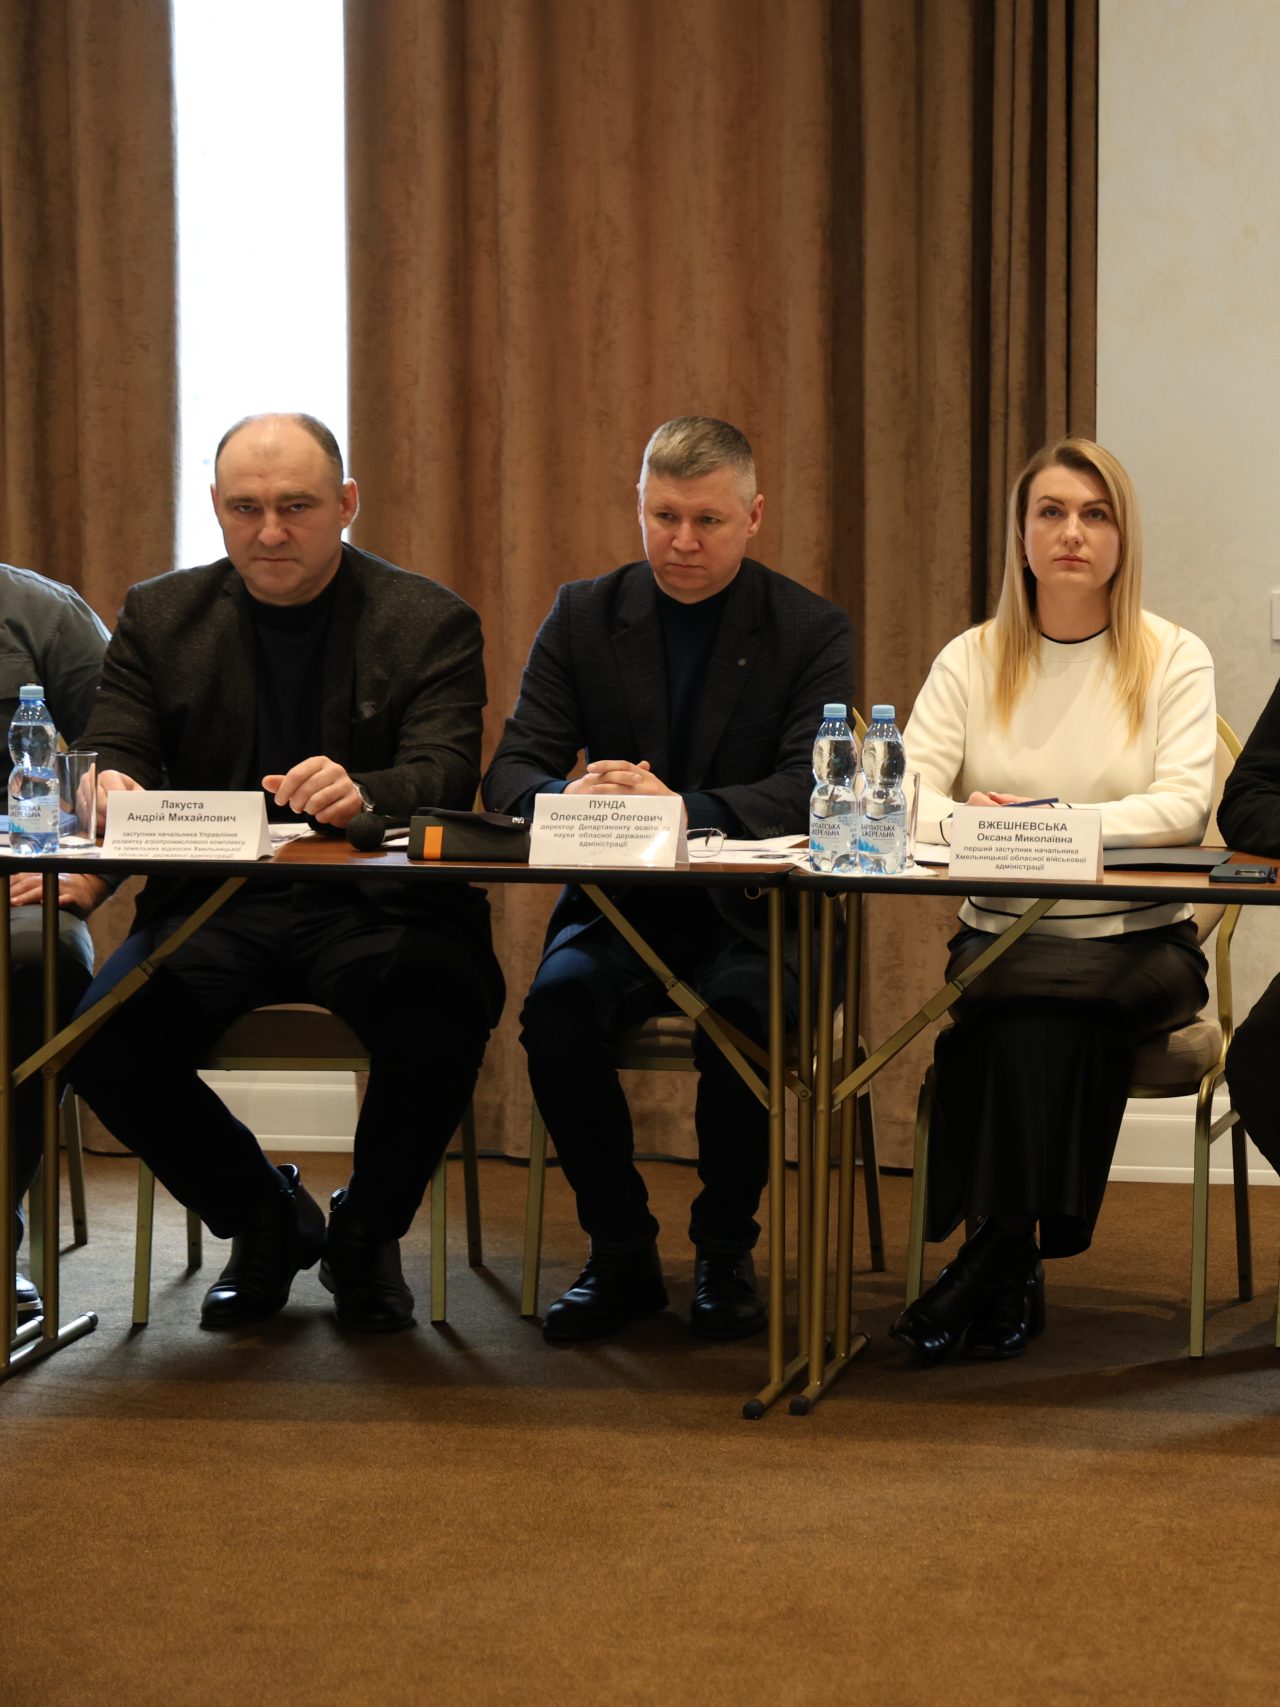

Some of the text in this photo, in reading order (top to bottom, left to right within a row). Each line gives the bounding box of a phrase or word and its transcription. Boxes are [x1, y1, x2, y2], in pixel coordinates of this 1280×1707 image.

[161, 800, 204, 811] Лакуста
[589, 800, 626, 810] ПУНДА
[127, 812, 236, 823] Андрій Михайлович
[550, 812, 663, 823] Олександр Олегович
[578, 824, 630, 832] Департаменту
[978, 820, 1068, 832] ВЖЕШНЕВСЬКА
[977, 833, 1073, 844] Оксана Миколаївна
[963, 846, 993, 854] перший
[955, 854, 1009, 862] Хмельницької
[995, 863, 1045, 871] адміністрації
